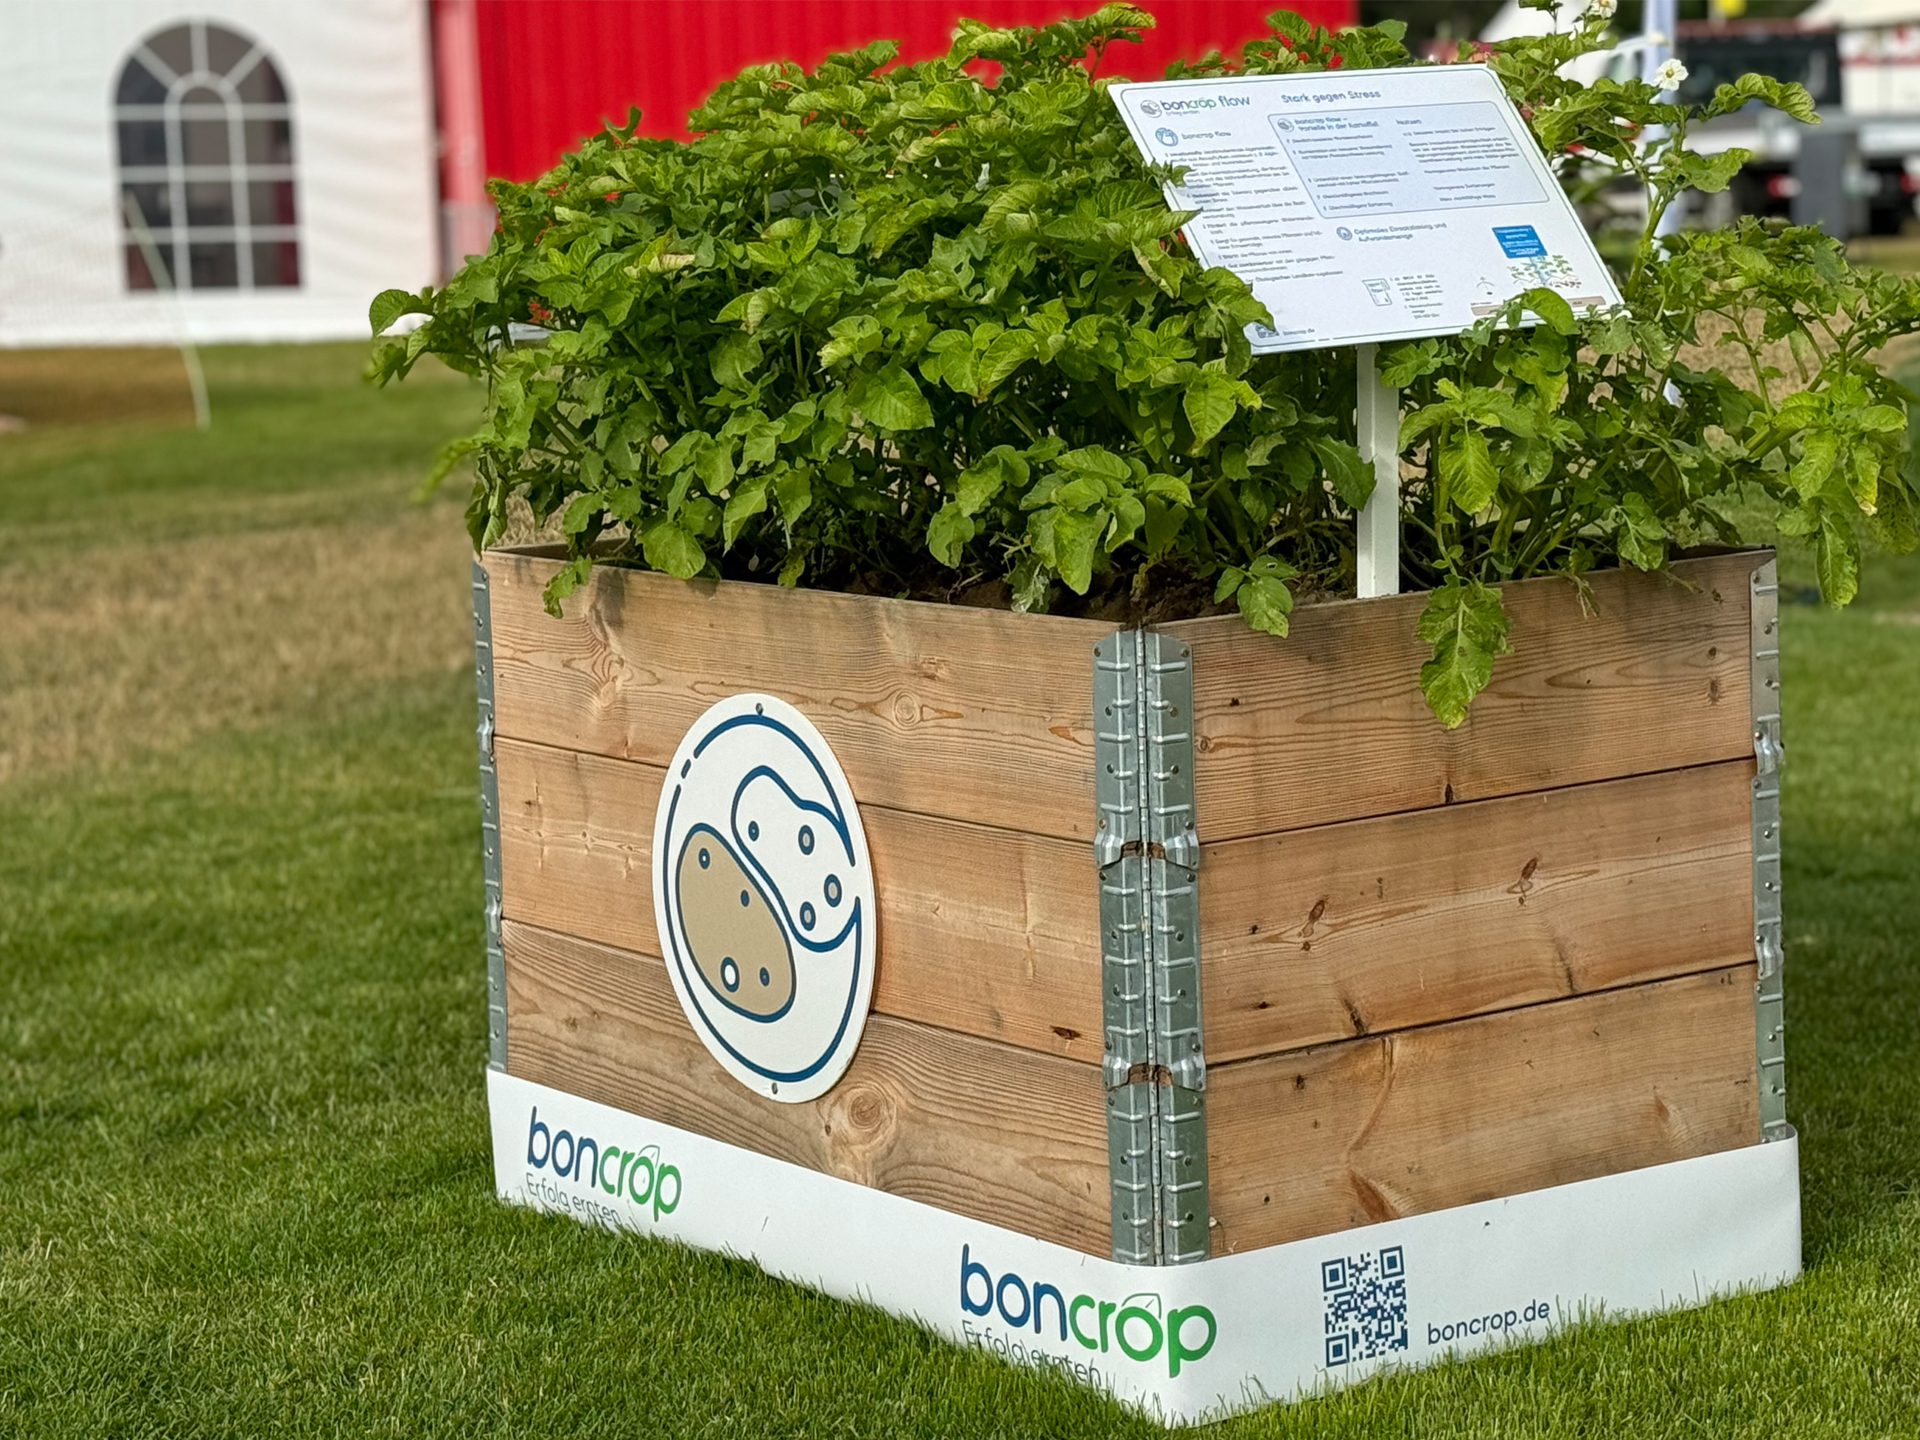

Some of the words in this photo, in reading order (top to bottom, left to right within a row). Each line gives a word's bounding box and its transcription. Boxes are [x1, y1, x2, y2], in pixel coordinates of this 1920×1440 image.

[1160, 97, 1217, 111] boncrop
[1218, 95, 1251, 107] flow
[1281, 92, 1311, 104] Stark
[1313, 91, 1346, 104] gegen
[1347, 90, 1381, 100] Stress
[527, 1105, 682, 1222] boncrop
[526, 1172, 571, 1214] Erfolg
[572, 1195, 622, 1224] ernten
[961, 1243, 1217, 1378] boncrop
[1428, 1298, 1550, 1345] boncrop.de
[962, 1319, 1025, 1363] Erfolg
